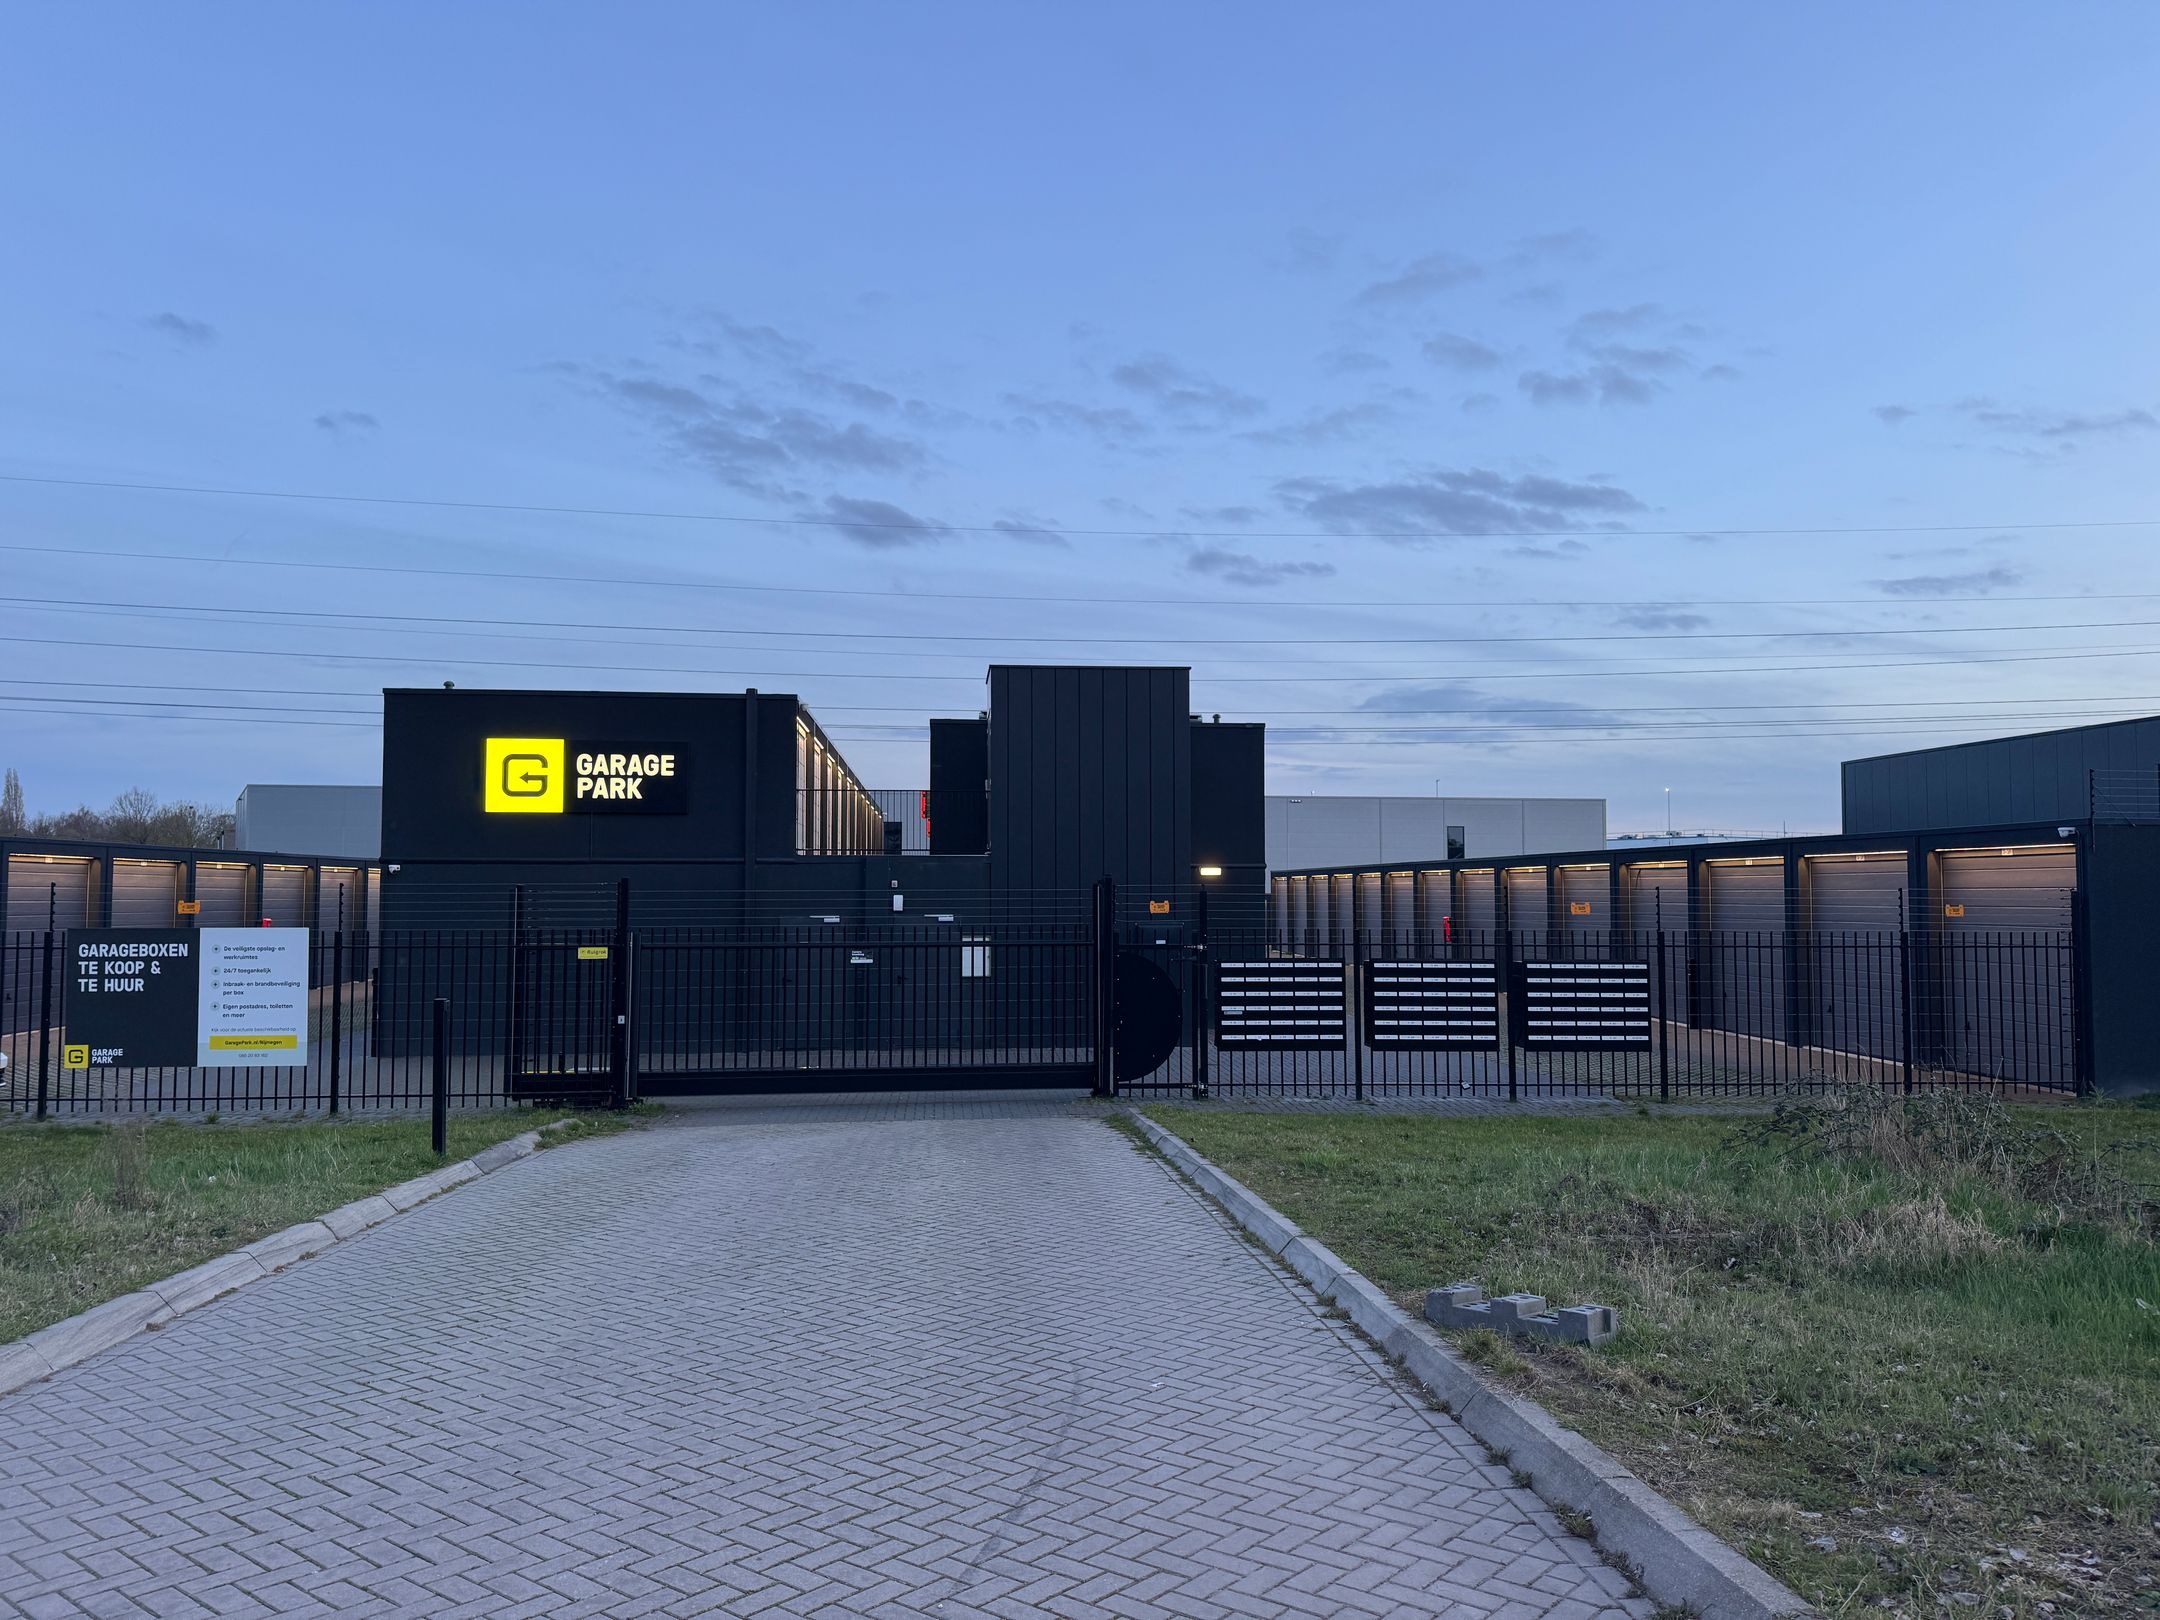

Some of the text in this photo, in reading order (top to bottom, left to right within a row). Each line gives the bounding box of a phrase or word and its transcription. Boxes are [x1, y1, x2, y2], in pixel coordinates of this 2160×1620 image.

[576, 753, 675, 777] GARAGE
[576, 777, 643, 799] PARK
[78, 943, 189, 957] GARAGEBOXEN
[78, 961, 161, 975] TE KOOP &
[237, 967, 272, 975] toegankelijk
[78, 978, 145, 992] TE HUUR
[91, 1048, 124, 1057] GARAGE
[91, 1056, 113, 1064] PARK
